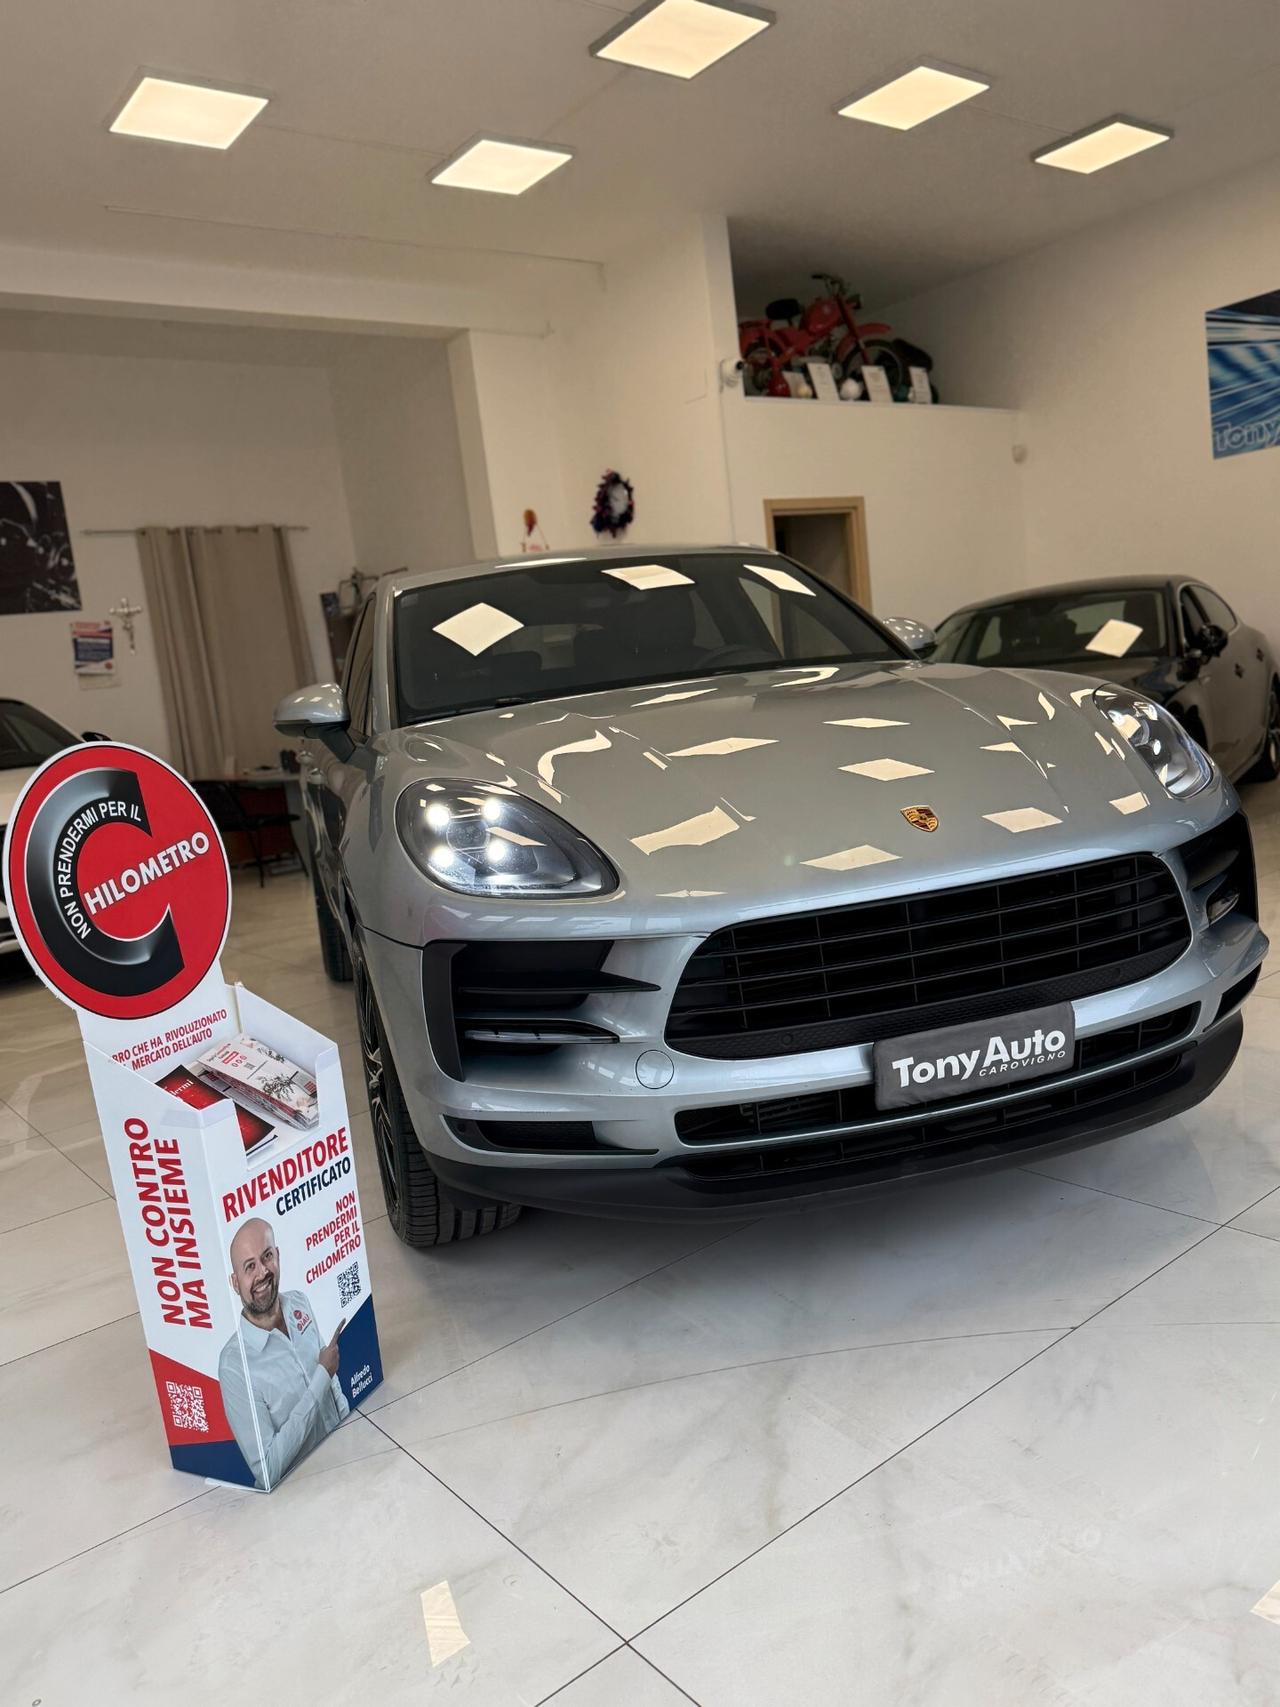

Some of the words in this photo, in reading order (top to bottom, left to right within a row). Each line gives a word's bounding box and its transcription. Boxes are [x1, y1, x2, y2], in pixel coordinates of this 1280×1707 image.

[98, 801, 128, 819] PER
[130, 809, 143, 822] IL
[57, 807, 99, 898] PRENDERMI
[64, 904, 91, 939] NON
[131, 1045, 171, 1071] MERCATO
[172, 1028, 213, 1053] DELL'AUTO
[132, 1041, 149, 1057] CHE
[150, 1036, 163, 1050] HA
[165, 1009, 227, 1043] RIVOLUZIONATO
[979, 1050, 1066, 1077] CAROVIGNO
[124, 1118, 170, 1247] CONTRO
[222, 1127, 349, 1223] RIVENDITORE
[276, 1156, 351, 1216] CERTIFICATO
[154, 1139, 202, 1270] INSIEME
[335, 1191, 356, 1214] NON
[305, 1205, 357, 1251] PRENDERMI
[334, 1228, 351, 1248] PER
[352, 1222, 360, 1236] IL
[306, 1235, 361, 1284] CHILOMETRO
[151, 1257, 186, 1326] NON
[182, 1279, 213, 1329] MA
